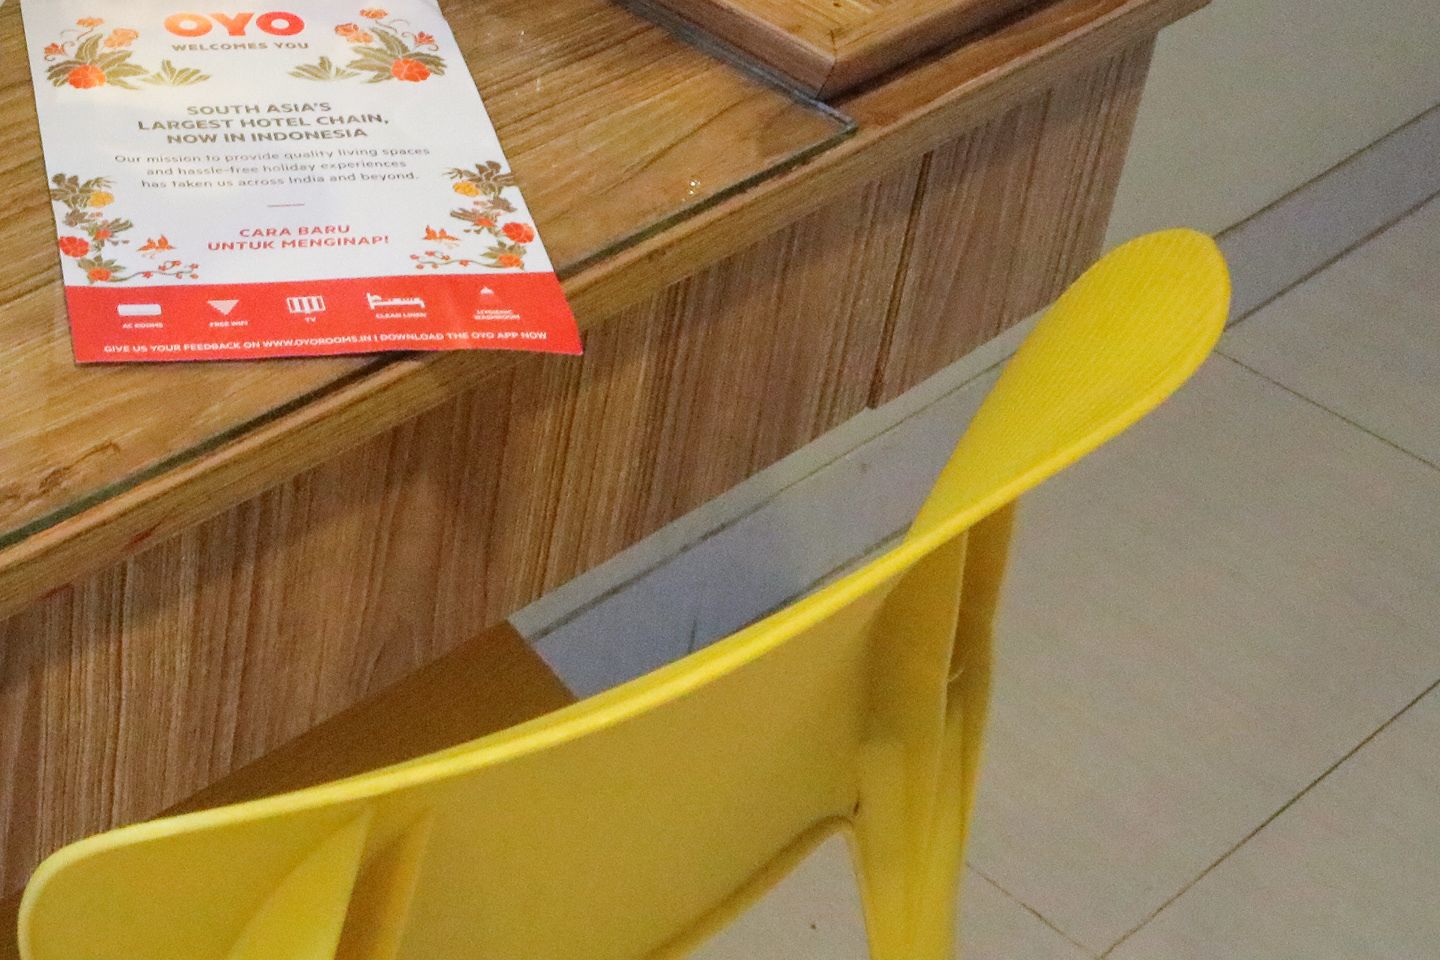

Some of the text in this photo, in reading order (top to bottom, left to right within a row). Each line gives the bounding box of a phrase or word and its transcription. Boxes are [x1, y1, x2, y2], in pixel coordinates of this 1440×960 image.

[164, 11, 305, 37] OYO
[172, 42, 310, 51] WELCOMES YOU
[186, 102, 332, 115] SOUTH ASIA'S
[138, 114, 389, 131] LARGEST HOTEL CHAIN,
[166, 128, 368, 144] NOW IN INDONESIA
[114, 147, 430, 163] Our mission to provide quality living spaces
[147, 159, 407, 176] and hassle-free holiday experiences
[141, 171, 419, 188] has taken us across India and beyond.
[239, 225, 351, 238] CARA BARU
[208, 234, 389, 252] UNTUK MENGINAP!
[104, 345, 131, 353] GIVE
[150, 344, 181, 352] YOUR
[184, 342, 241, 352] FEEDBACK
[380, 332, 444, 341] DOWNLOAD
[447, 331, 469, 340] THE
[471, 331, 495, 339] OYO
[497, 331, 519, 339] APP
[521, 331, 547, 340] NOW
